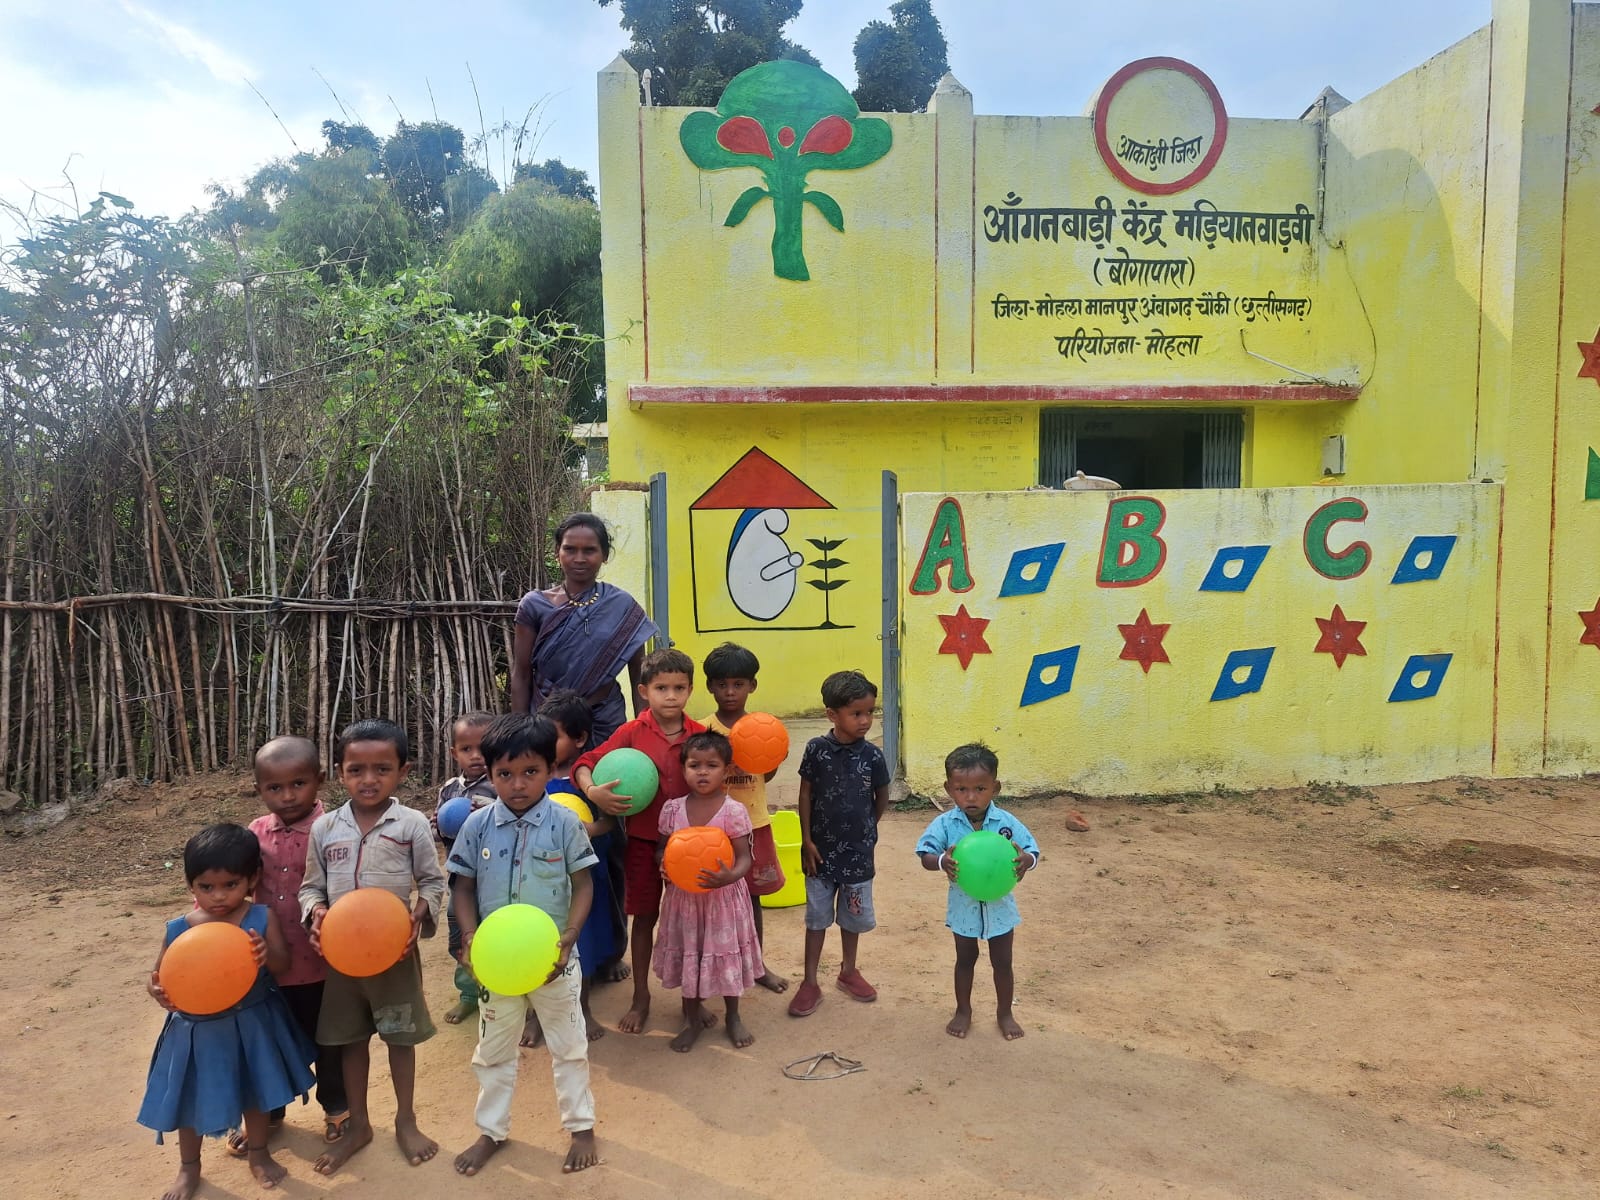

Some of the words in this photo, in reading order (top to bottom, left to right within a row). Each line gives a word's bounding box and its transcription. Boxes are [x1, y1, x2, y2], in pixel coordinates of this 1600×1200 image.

[1168, 135, 1203, 164] जिला
[1121, 199, 1168, 249] केंद्र
[1085, 297, 1140, 325] मानपुर
[1195, 291, 1232, 317] चौकी
[1145, 328, 1203, 360] मोहला
[909, 496, 976, 595] A
[1096, 495, 1168, 588] B
[1303, 496, 1373, 580] C
